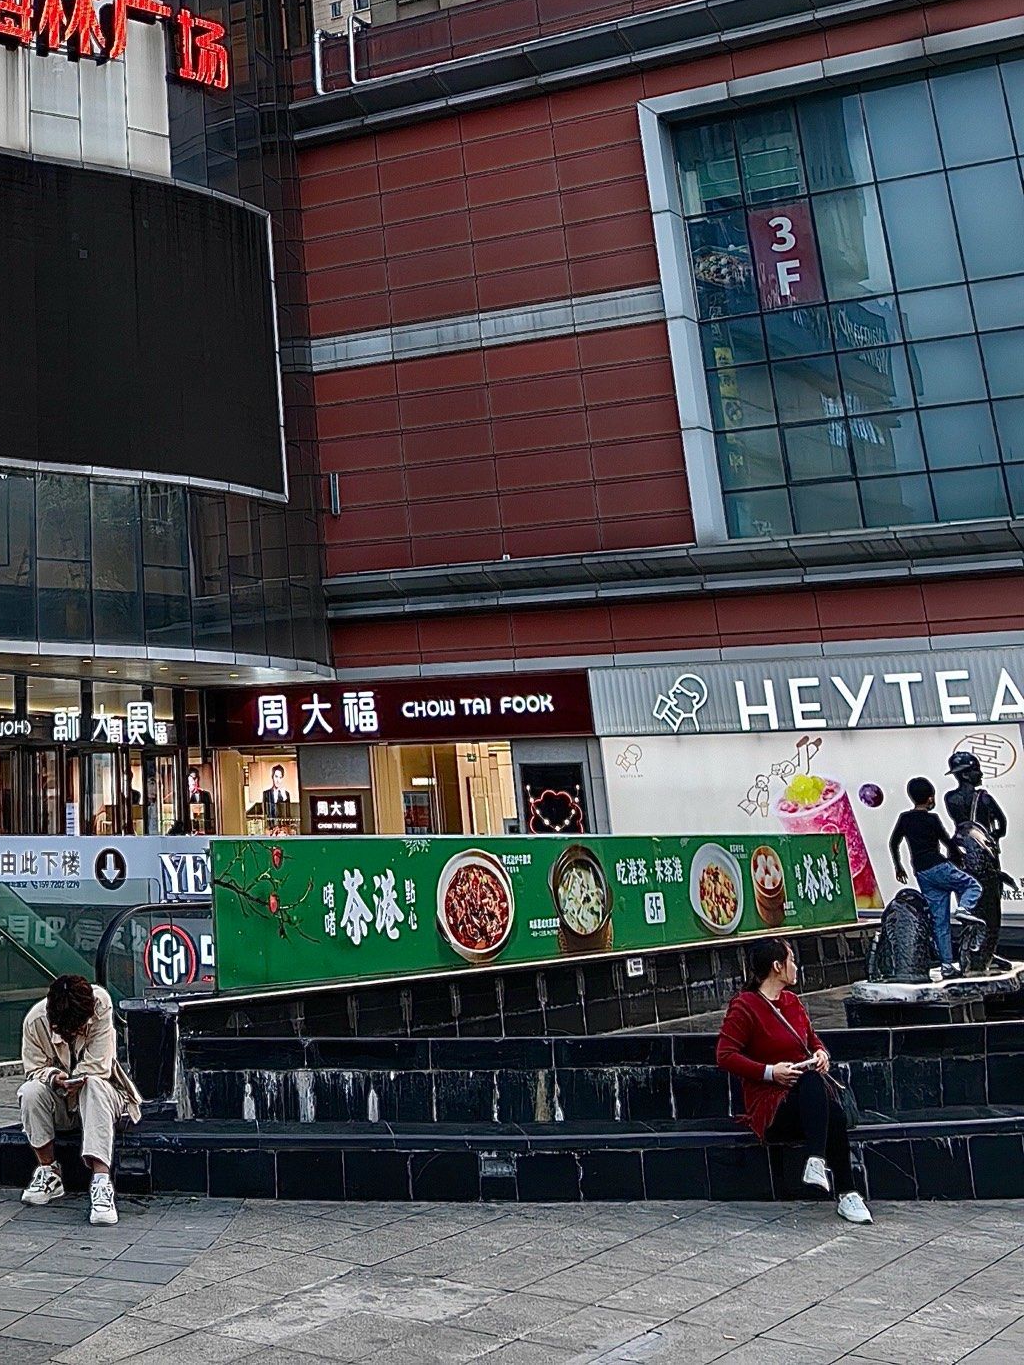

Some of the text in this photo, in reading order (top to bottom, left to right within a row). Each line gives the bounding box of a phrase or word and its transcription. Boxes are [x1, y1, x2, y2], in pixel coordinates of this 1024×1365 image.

[257, 691, 379, 736] 周大福
[402, 692, 555, 718] CHOW TAI FOOK
[735, 667, 1024, 730] HEYTEA
[317, 800, 356, 816] 周大福
[159, 853, 213, 895] YE
[340, 868, 404, 946] 茶港
[649, 896, 661, 920] 3F
